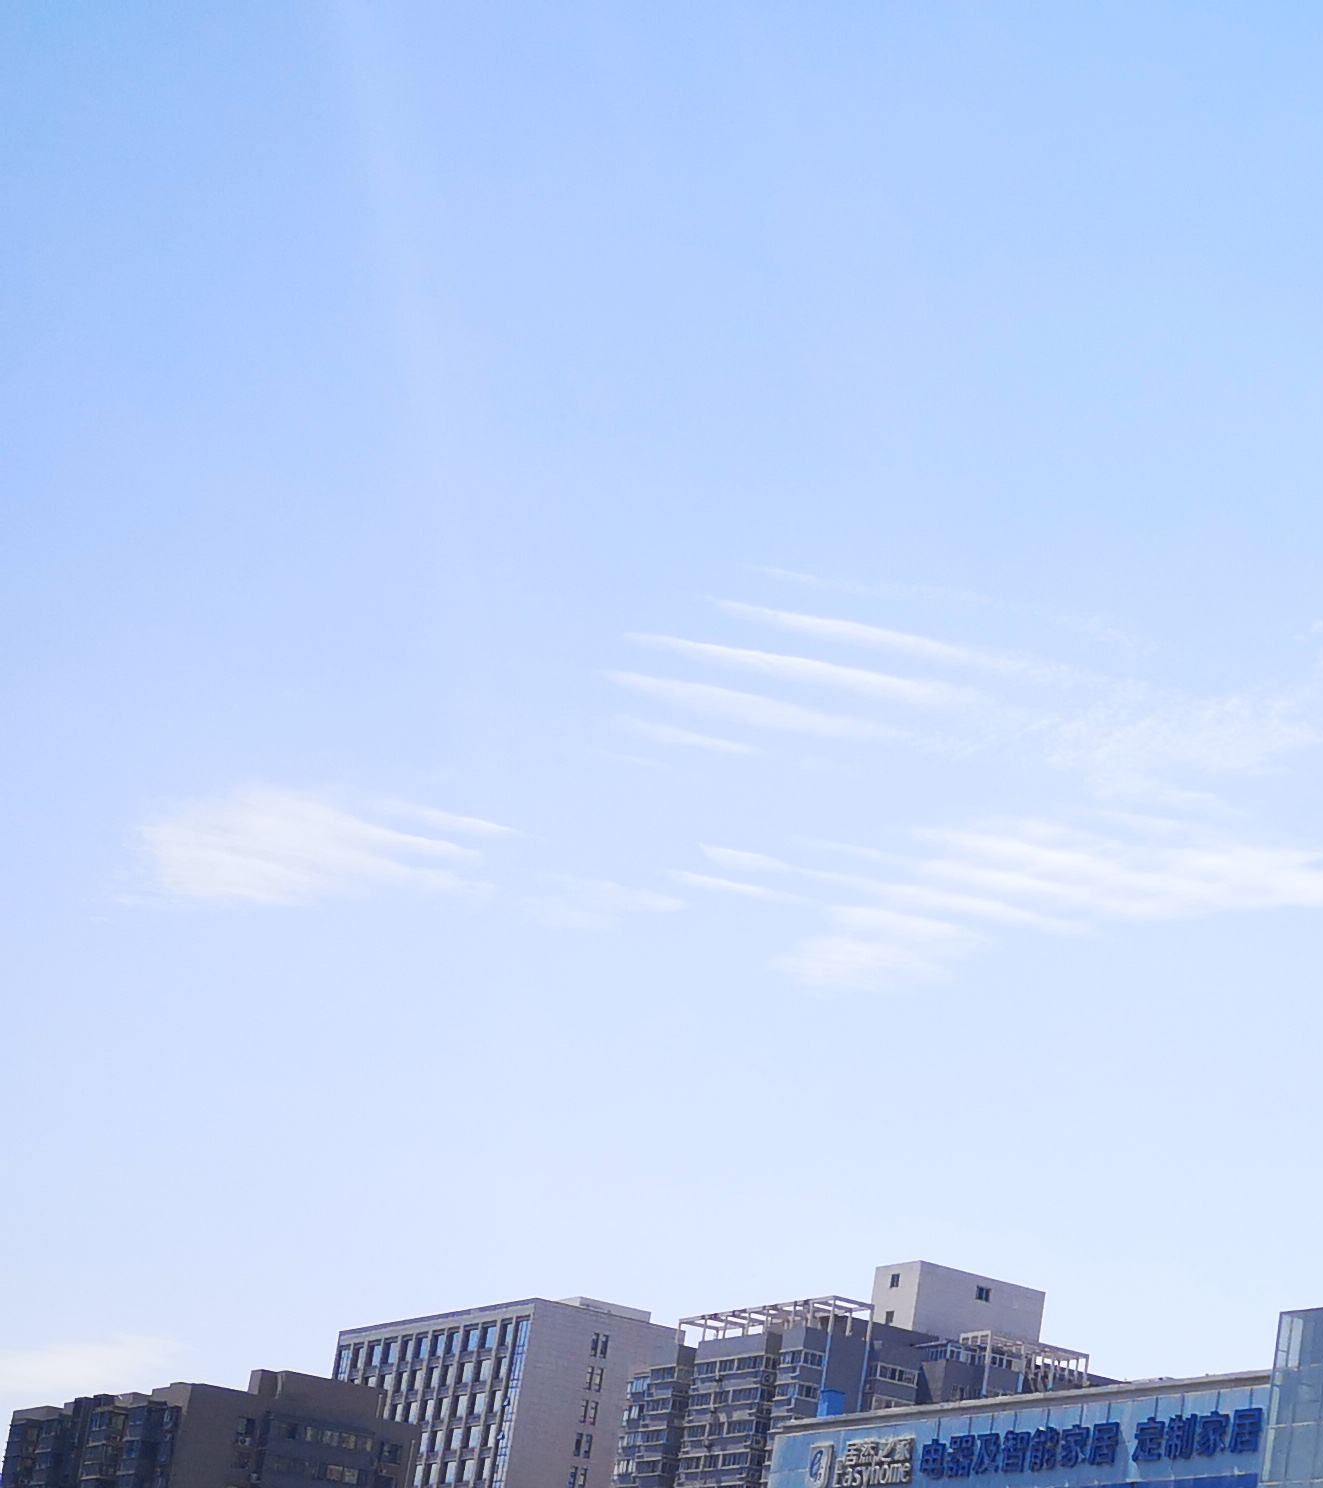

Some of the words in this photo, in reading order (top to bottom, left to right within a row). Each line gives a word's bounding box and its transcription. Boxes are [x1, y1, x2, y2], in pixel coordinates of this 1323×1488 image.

[843, 1438, 915, 1467] 居然之家
[919, 1421, 1119, 1478] 电器及智能家居
[1132, 1407, 1263, 1462] 定制家居
